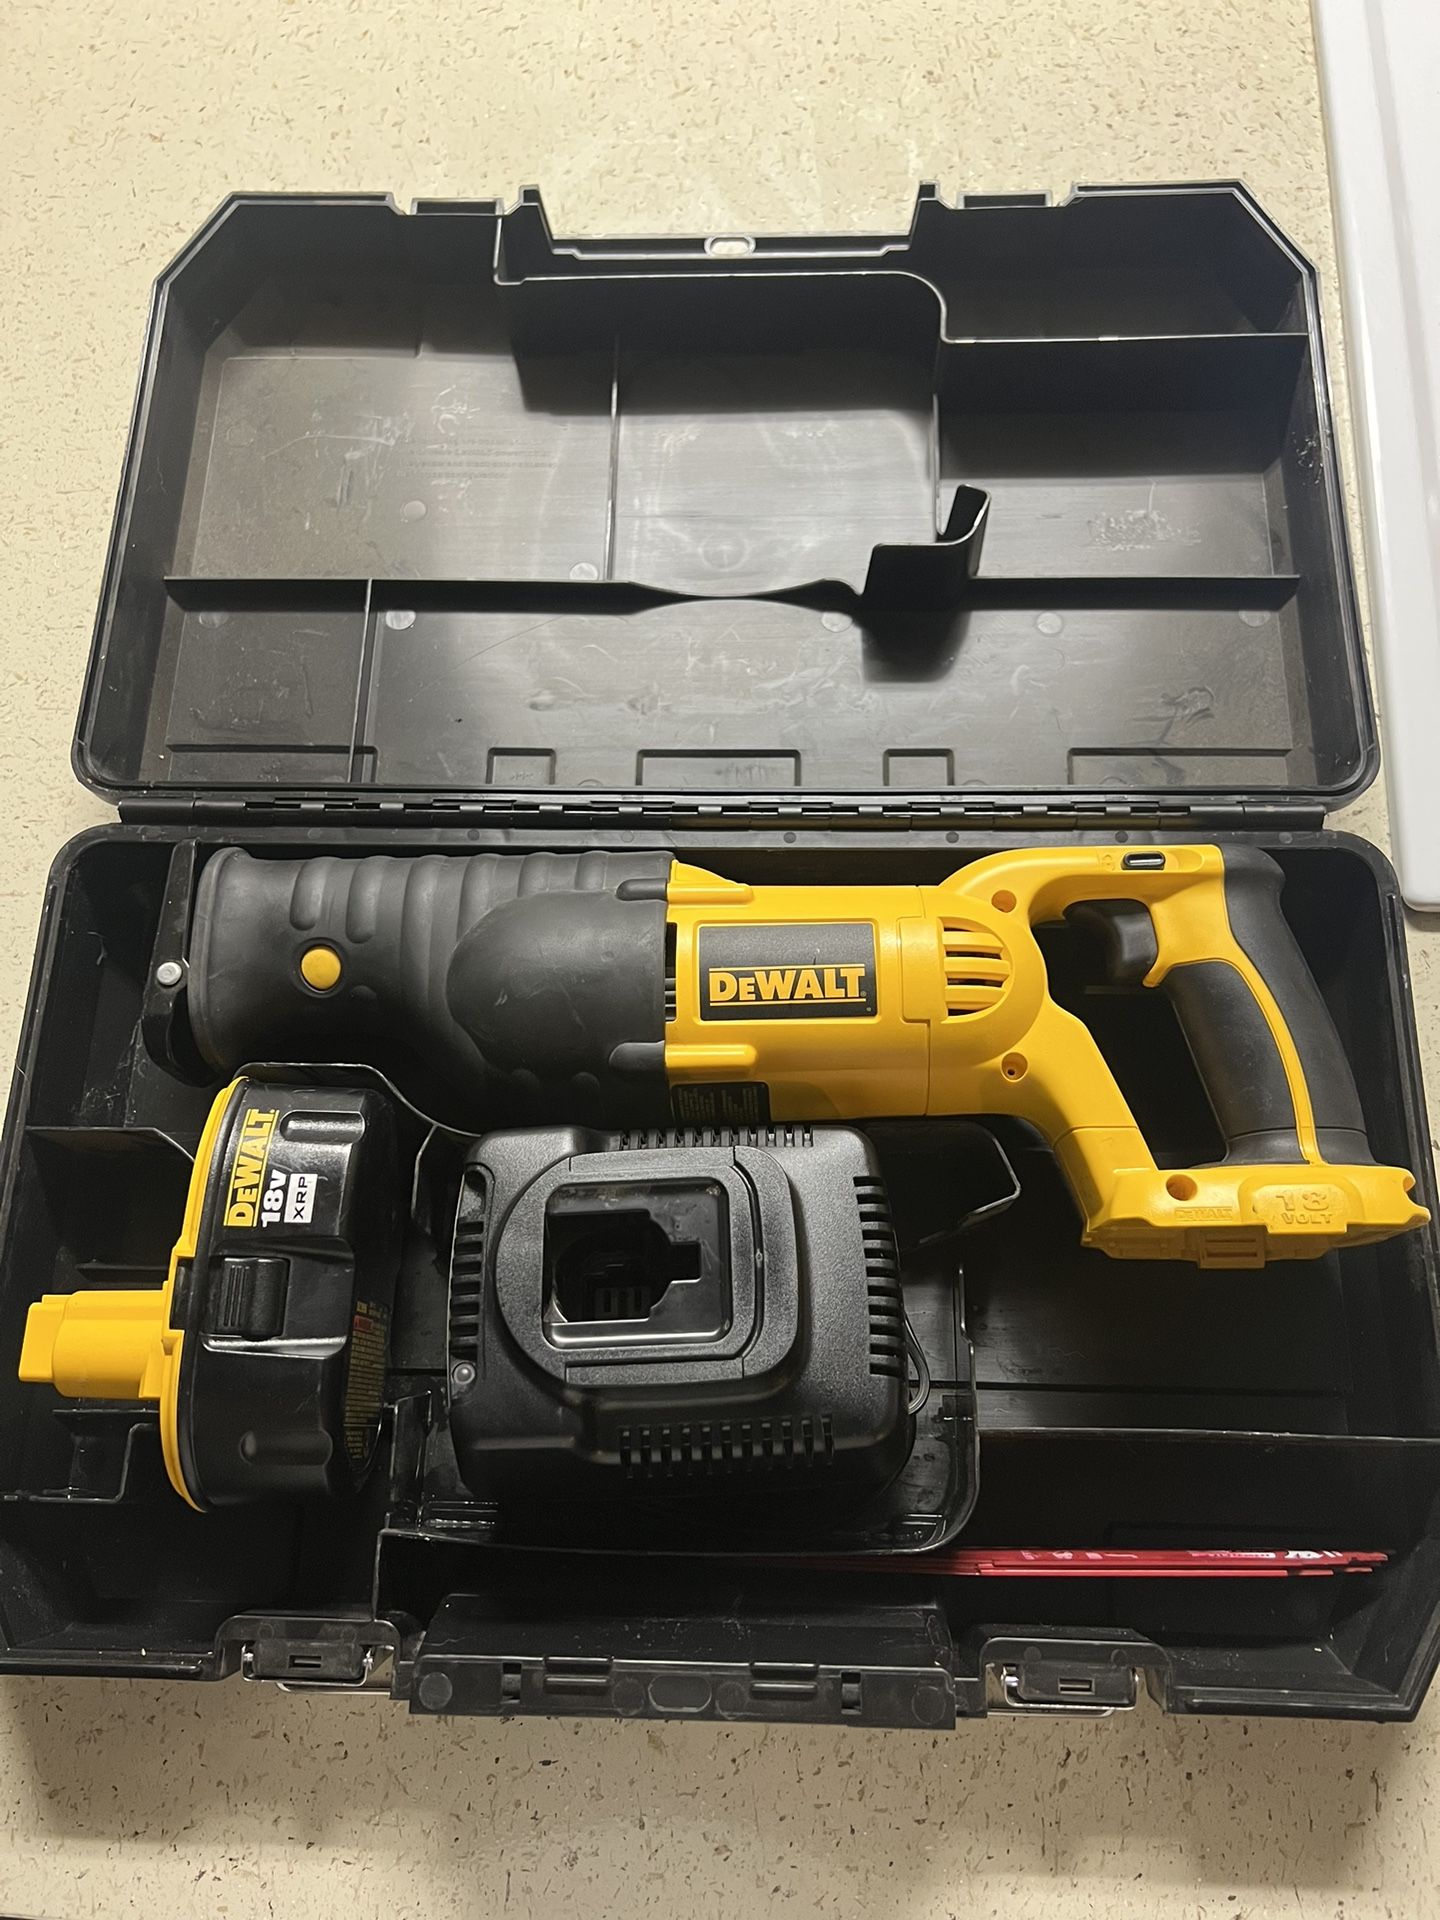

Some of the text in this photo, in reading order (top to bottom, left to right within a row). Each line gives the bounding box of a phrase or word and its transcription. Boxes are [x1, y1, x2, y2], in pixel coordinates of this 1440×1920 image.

[709, 968, 865, 1001] DEWALT
[227, 1108, 275, 1227] DEWALT
[261, 1169, 288, 1227] 18V
[293, 1176, 308, 1219] XRP
[1275, 1190, 1330, 1211] 18
[1281, 1212, 1333, 1224] VOLT
